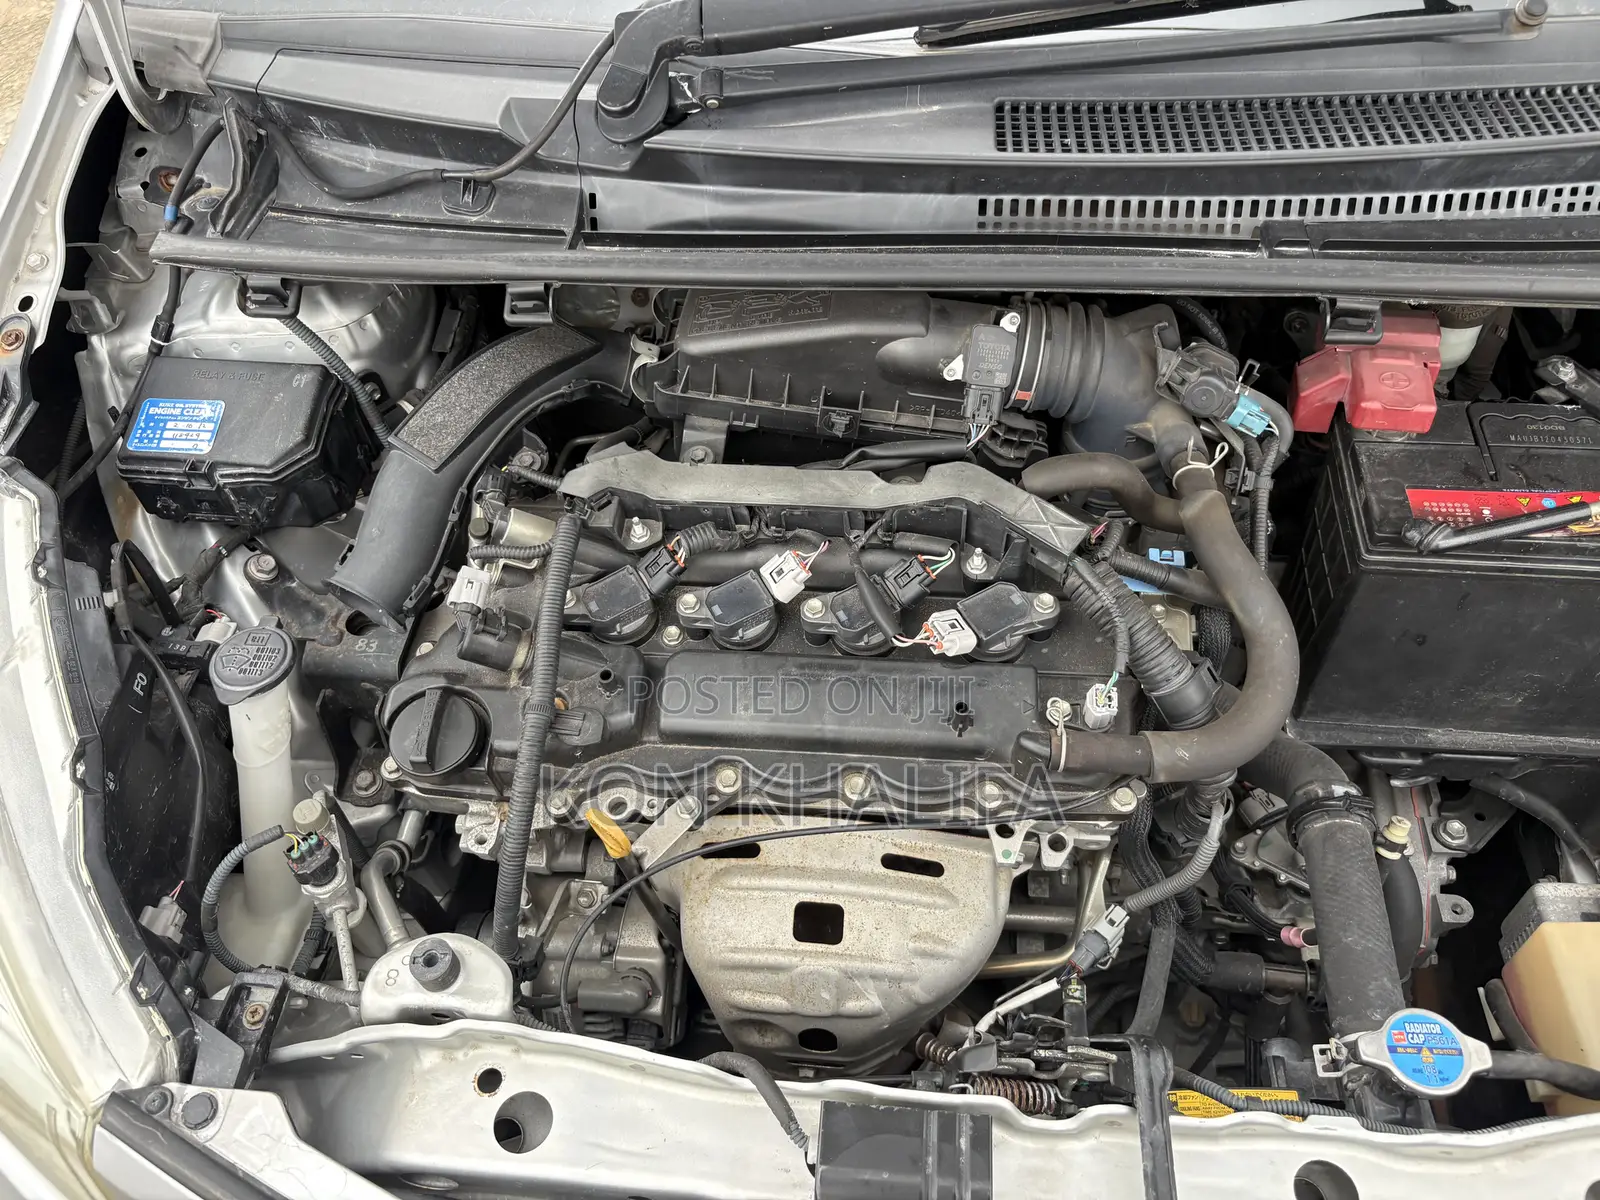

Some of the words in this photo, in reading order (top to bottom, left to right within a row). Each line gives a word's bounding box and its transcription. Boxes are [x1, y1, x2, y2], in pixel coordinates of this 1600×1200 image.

[978, 341, 1011, 351] TOYOTA
[978, 362, 1003, 370] DENSO
[191, 369, 225, 381] RELAY
[239, 371, 266, 382] FUSE
[148, 407, 183, 415] ENGINE
[1404, 1022, 1443, 1034] RADIATOR
[1407, 1033, 1425, 1044] CAP
[1423, 1065, 1437, 1074] 108
